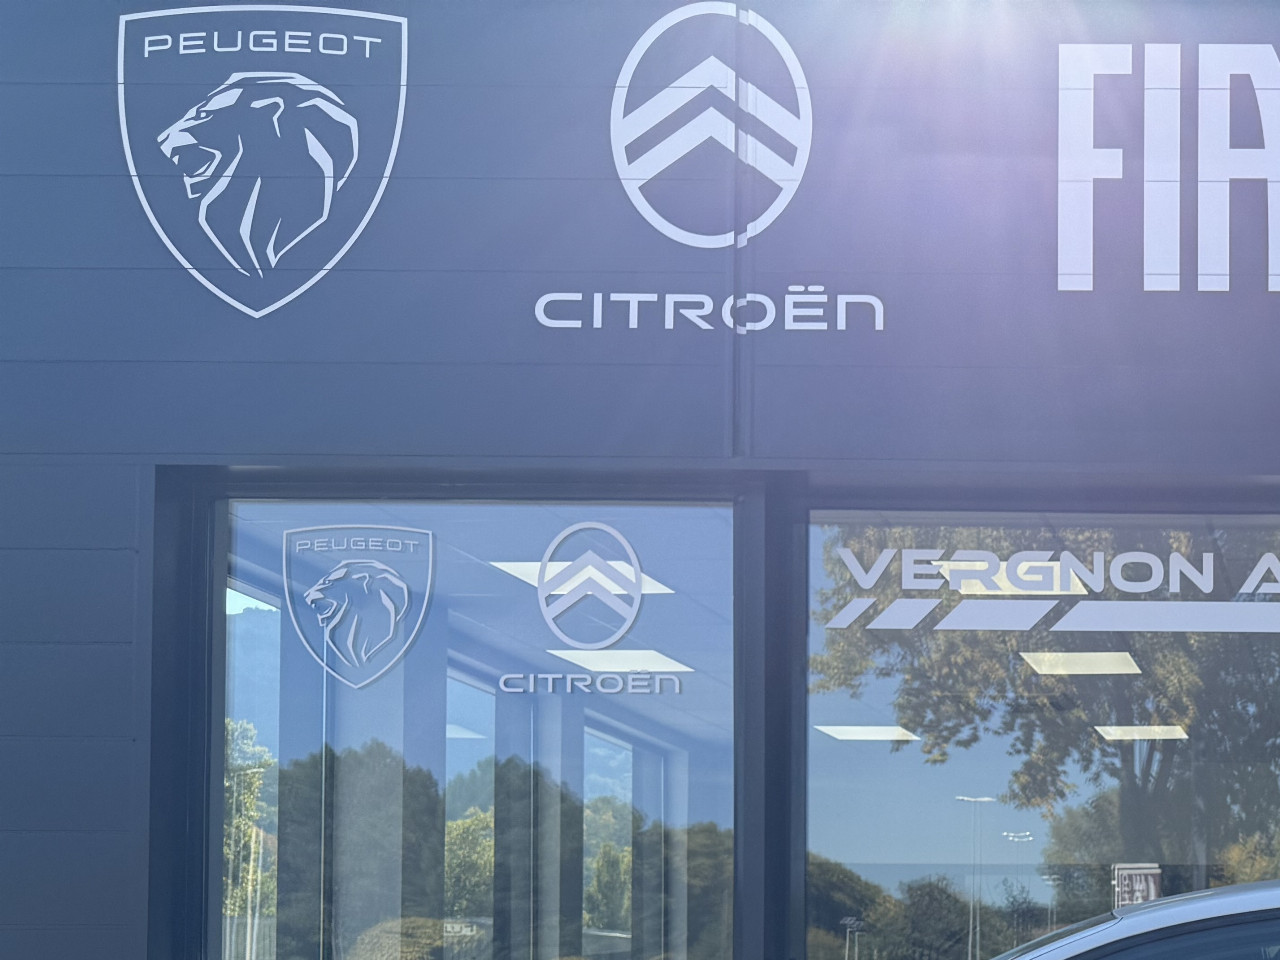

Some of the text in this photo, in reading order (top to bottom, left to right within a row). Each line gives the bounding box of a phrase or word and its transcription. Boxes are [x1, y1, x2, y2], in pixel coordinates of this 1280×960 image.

[144, 31, 382, 58] PEUGEOT
[295, 536, 420, 553] PEUGEOT
[837, 548, 1214, 594] VERGNON
